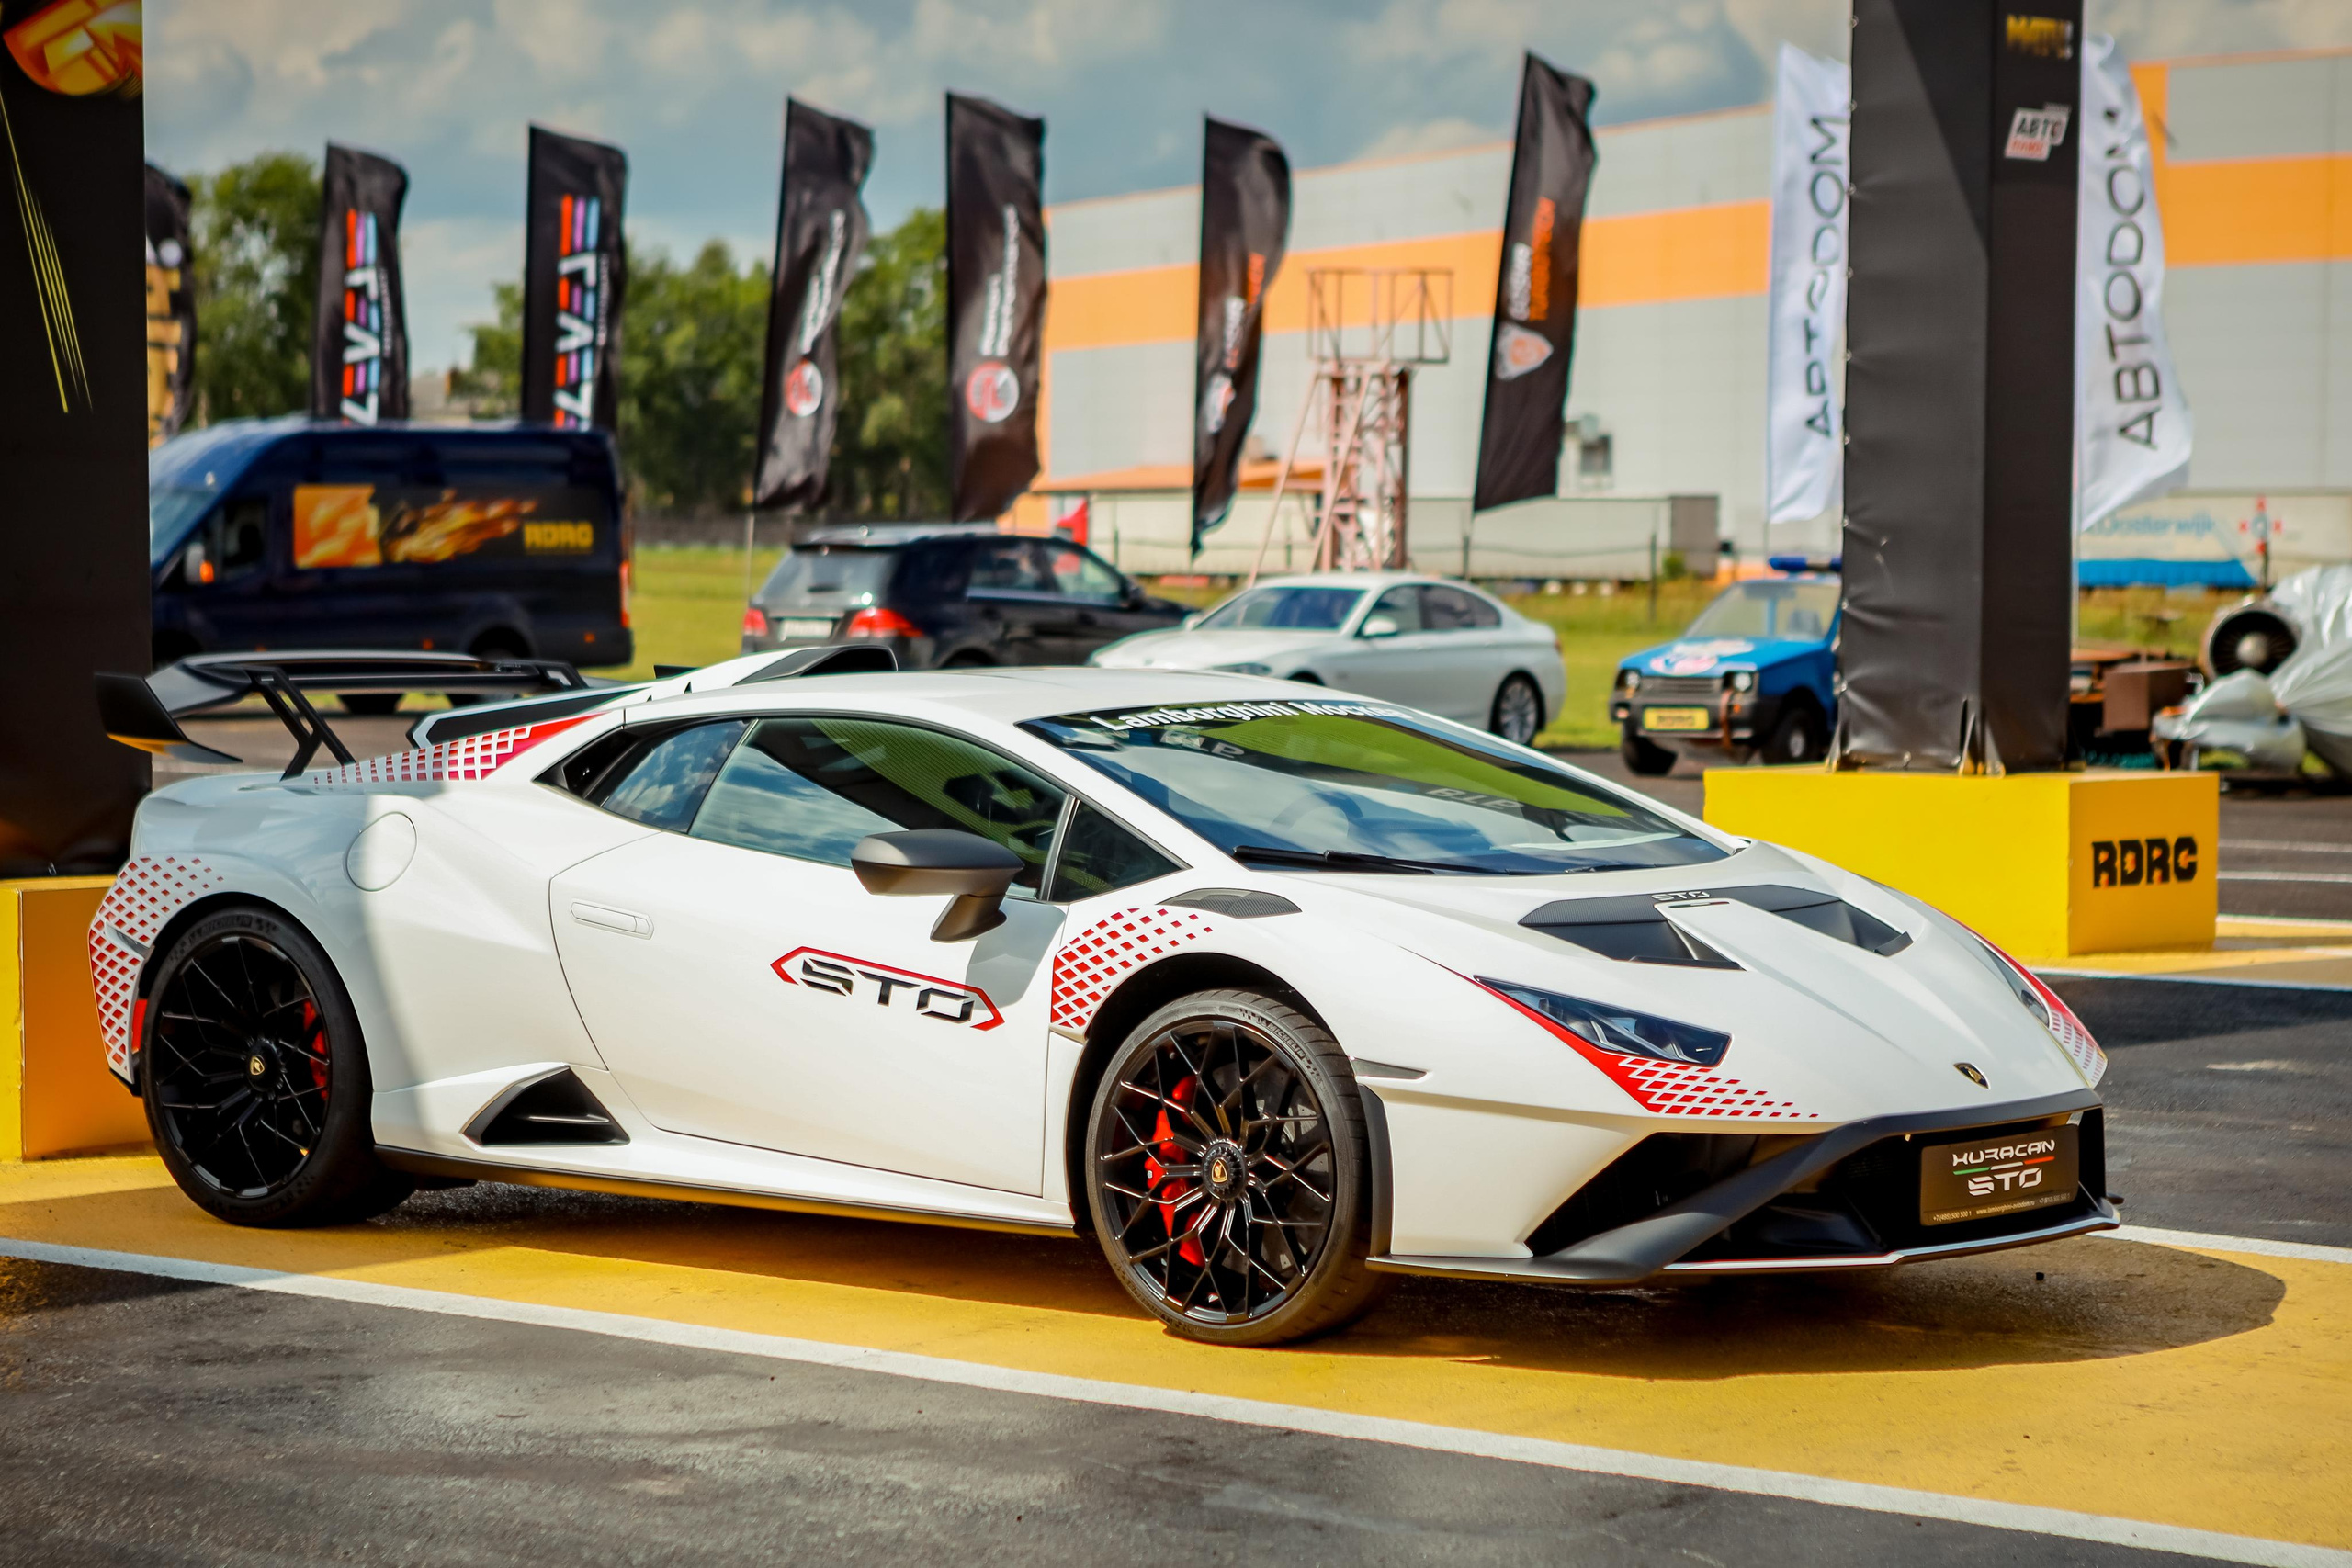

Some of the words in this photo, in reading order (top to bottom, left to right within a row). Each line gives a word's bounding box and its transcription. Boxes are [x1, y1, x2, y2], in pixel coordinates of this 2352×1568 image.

[1090, 702, 1299, 731] Lamborghini
[2092, 836, 2198, 889] RDRC
[1651, 890, 1711, 901] STO
[799, 957, 975, 1025] STO
[1266, 1021, 1306, 1061] MICHELIN
[1967, 1167, 2043, 1198] STO
